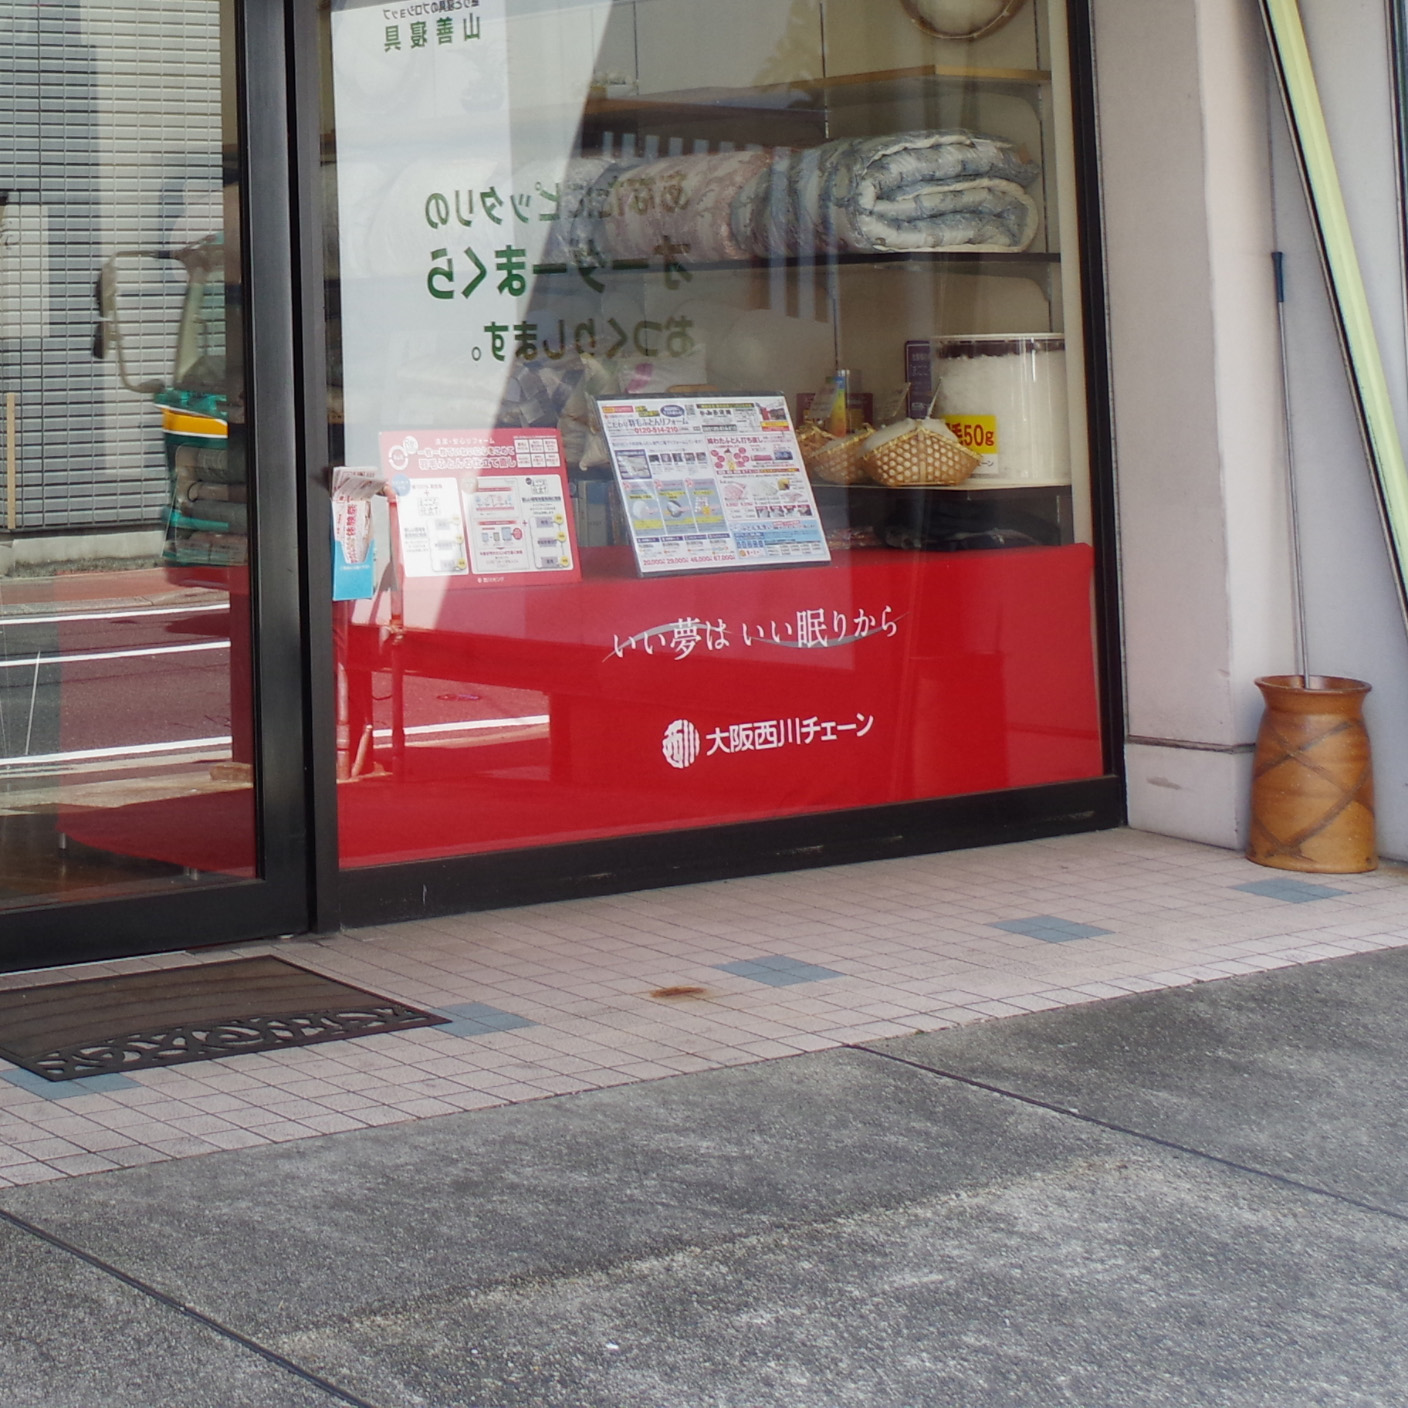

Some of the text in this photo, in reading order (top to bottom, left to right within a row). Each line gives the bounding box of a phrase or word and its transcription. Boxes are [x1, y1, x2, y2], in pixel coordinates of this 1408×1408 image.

[611, 604, 898, 660] いい夢は いい眠りから
[706, 712, 874, 757] 大阪西川チェーン
